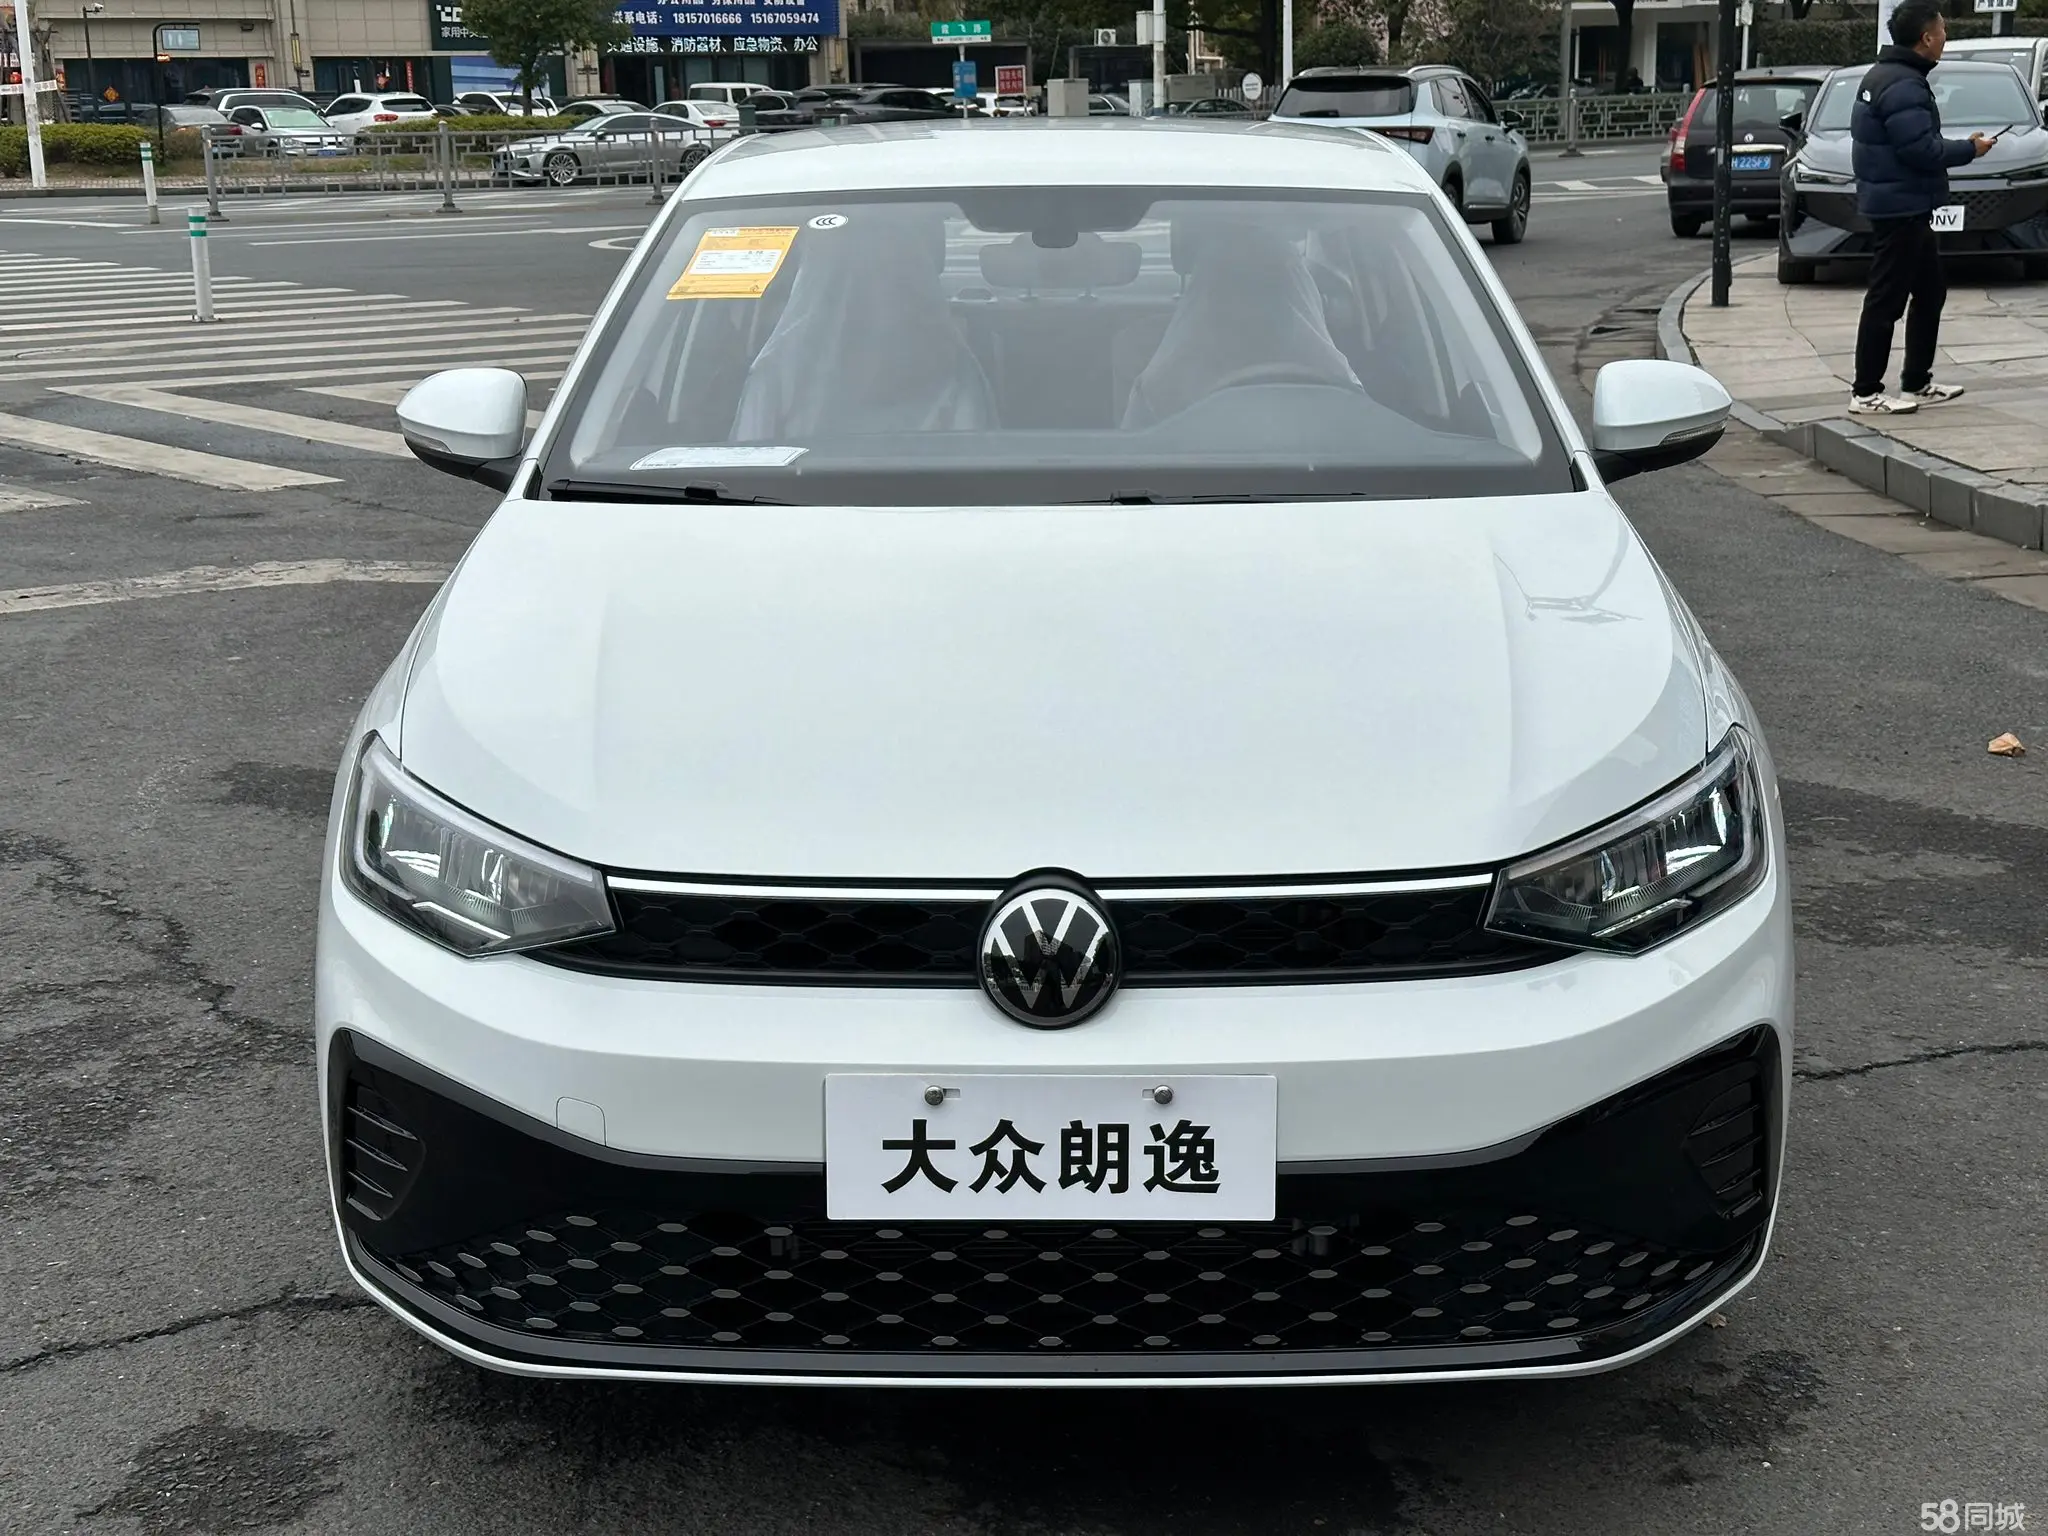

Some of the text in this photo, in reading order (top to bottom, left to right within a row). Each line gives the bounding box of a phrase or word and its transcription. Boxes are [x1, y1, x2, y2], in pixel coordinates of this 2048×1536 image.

[672, 12, 742, 24] 18157016666
[750, 12, 820, 24] 15167059474
[815, 216, 838, 227] CCC
[881, 1118, 1222, 1195] 大众朗逸
